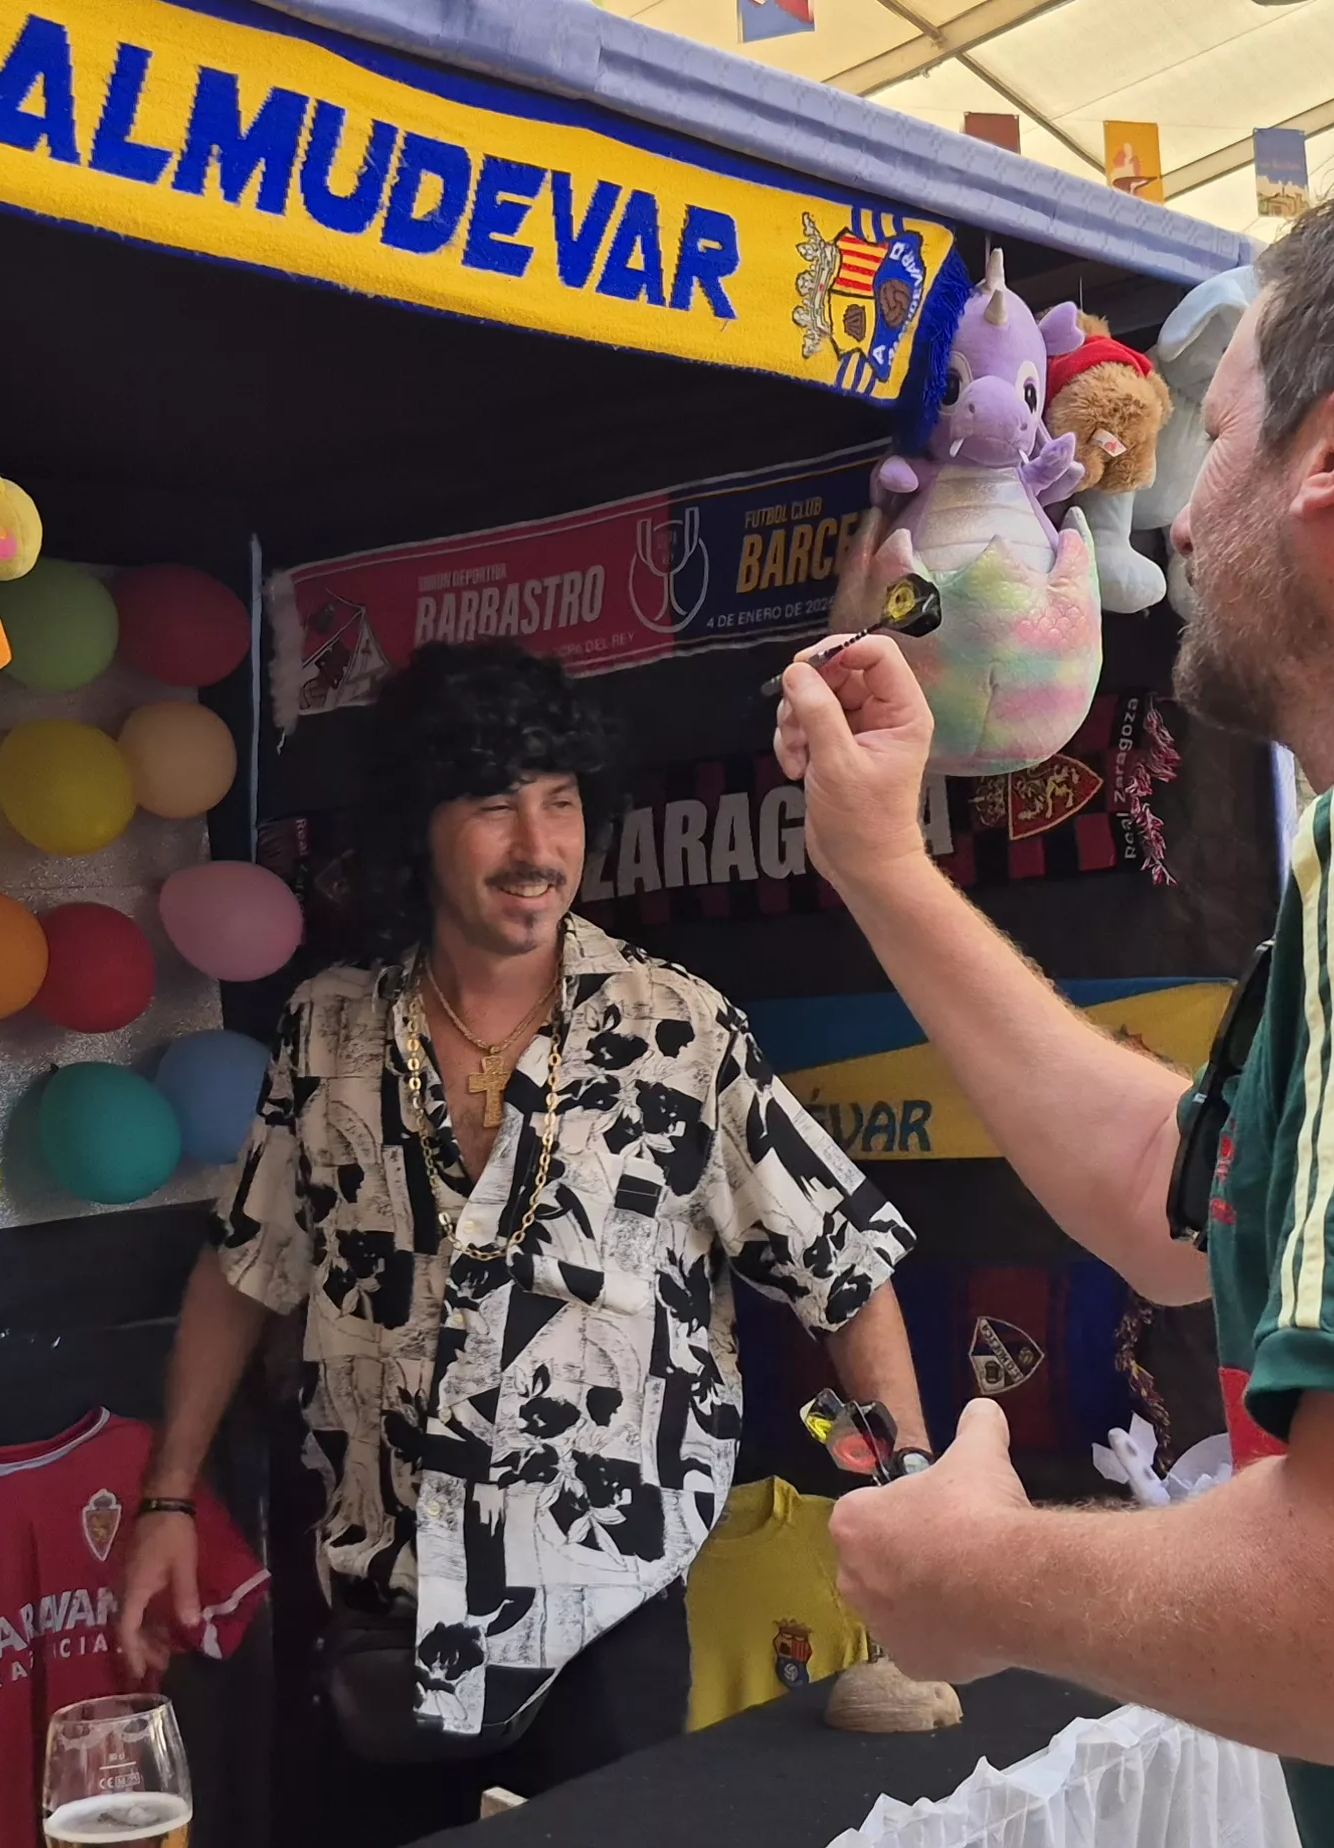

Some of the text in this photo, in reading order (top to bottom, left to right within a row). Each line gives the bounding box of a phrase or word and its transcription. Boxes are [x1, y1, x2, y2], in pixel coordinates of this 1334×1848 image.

[744, 497, 823, 529] FUTBOL CLUB
[415, 564, 606, 646] BARBASTRO
[706, 616, 715, 628] 4
[717, 614, 735, 627] DE
[738, 606, 782, 626] ENERO
[785, 603, 803, 617] DE
[585, 637, 609, 653] DEL
[611, 631, 636, 648] REY
[1116, 811, 1137, 859] Real
